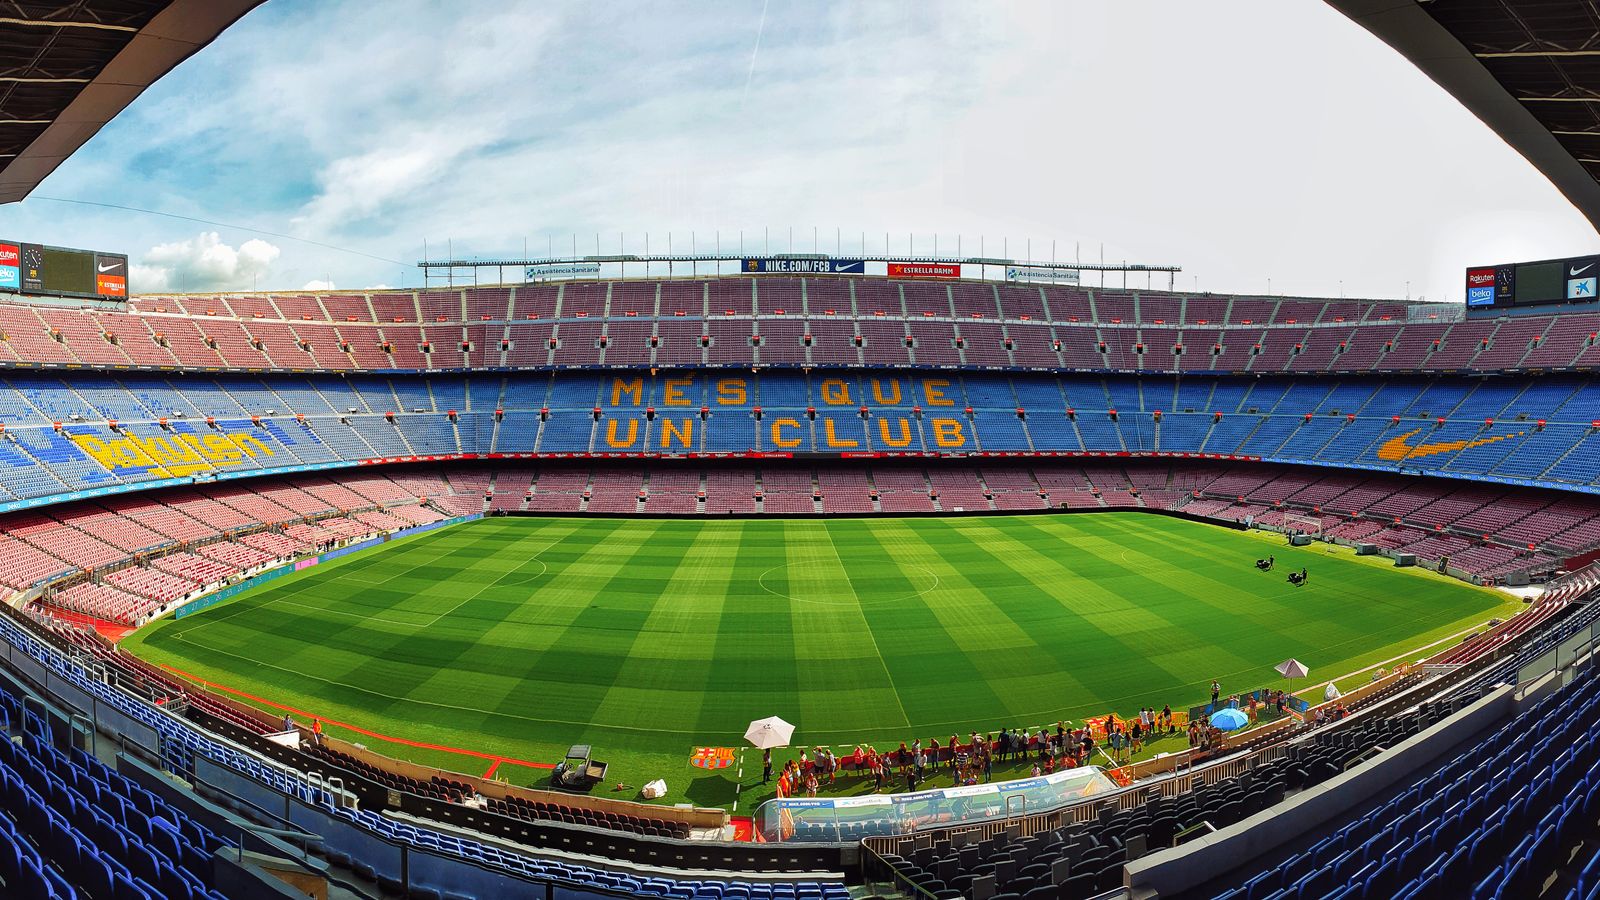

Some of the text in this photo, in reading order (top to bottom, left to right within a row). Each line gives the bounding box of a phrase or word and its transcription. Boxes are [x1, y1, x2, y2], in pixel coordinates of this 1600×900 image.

[766, 260, 830, 272] NIKE.COM/FCB
[1470, 274, 1495, 282] Rakuten
[1472, 290, 1490, 298] beko
[821, 379, 954, 406] QUE
[606, 418, 966, 448] UN CLUB
